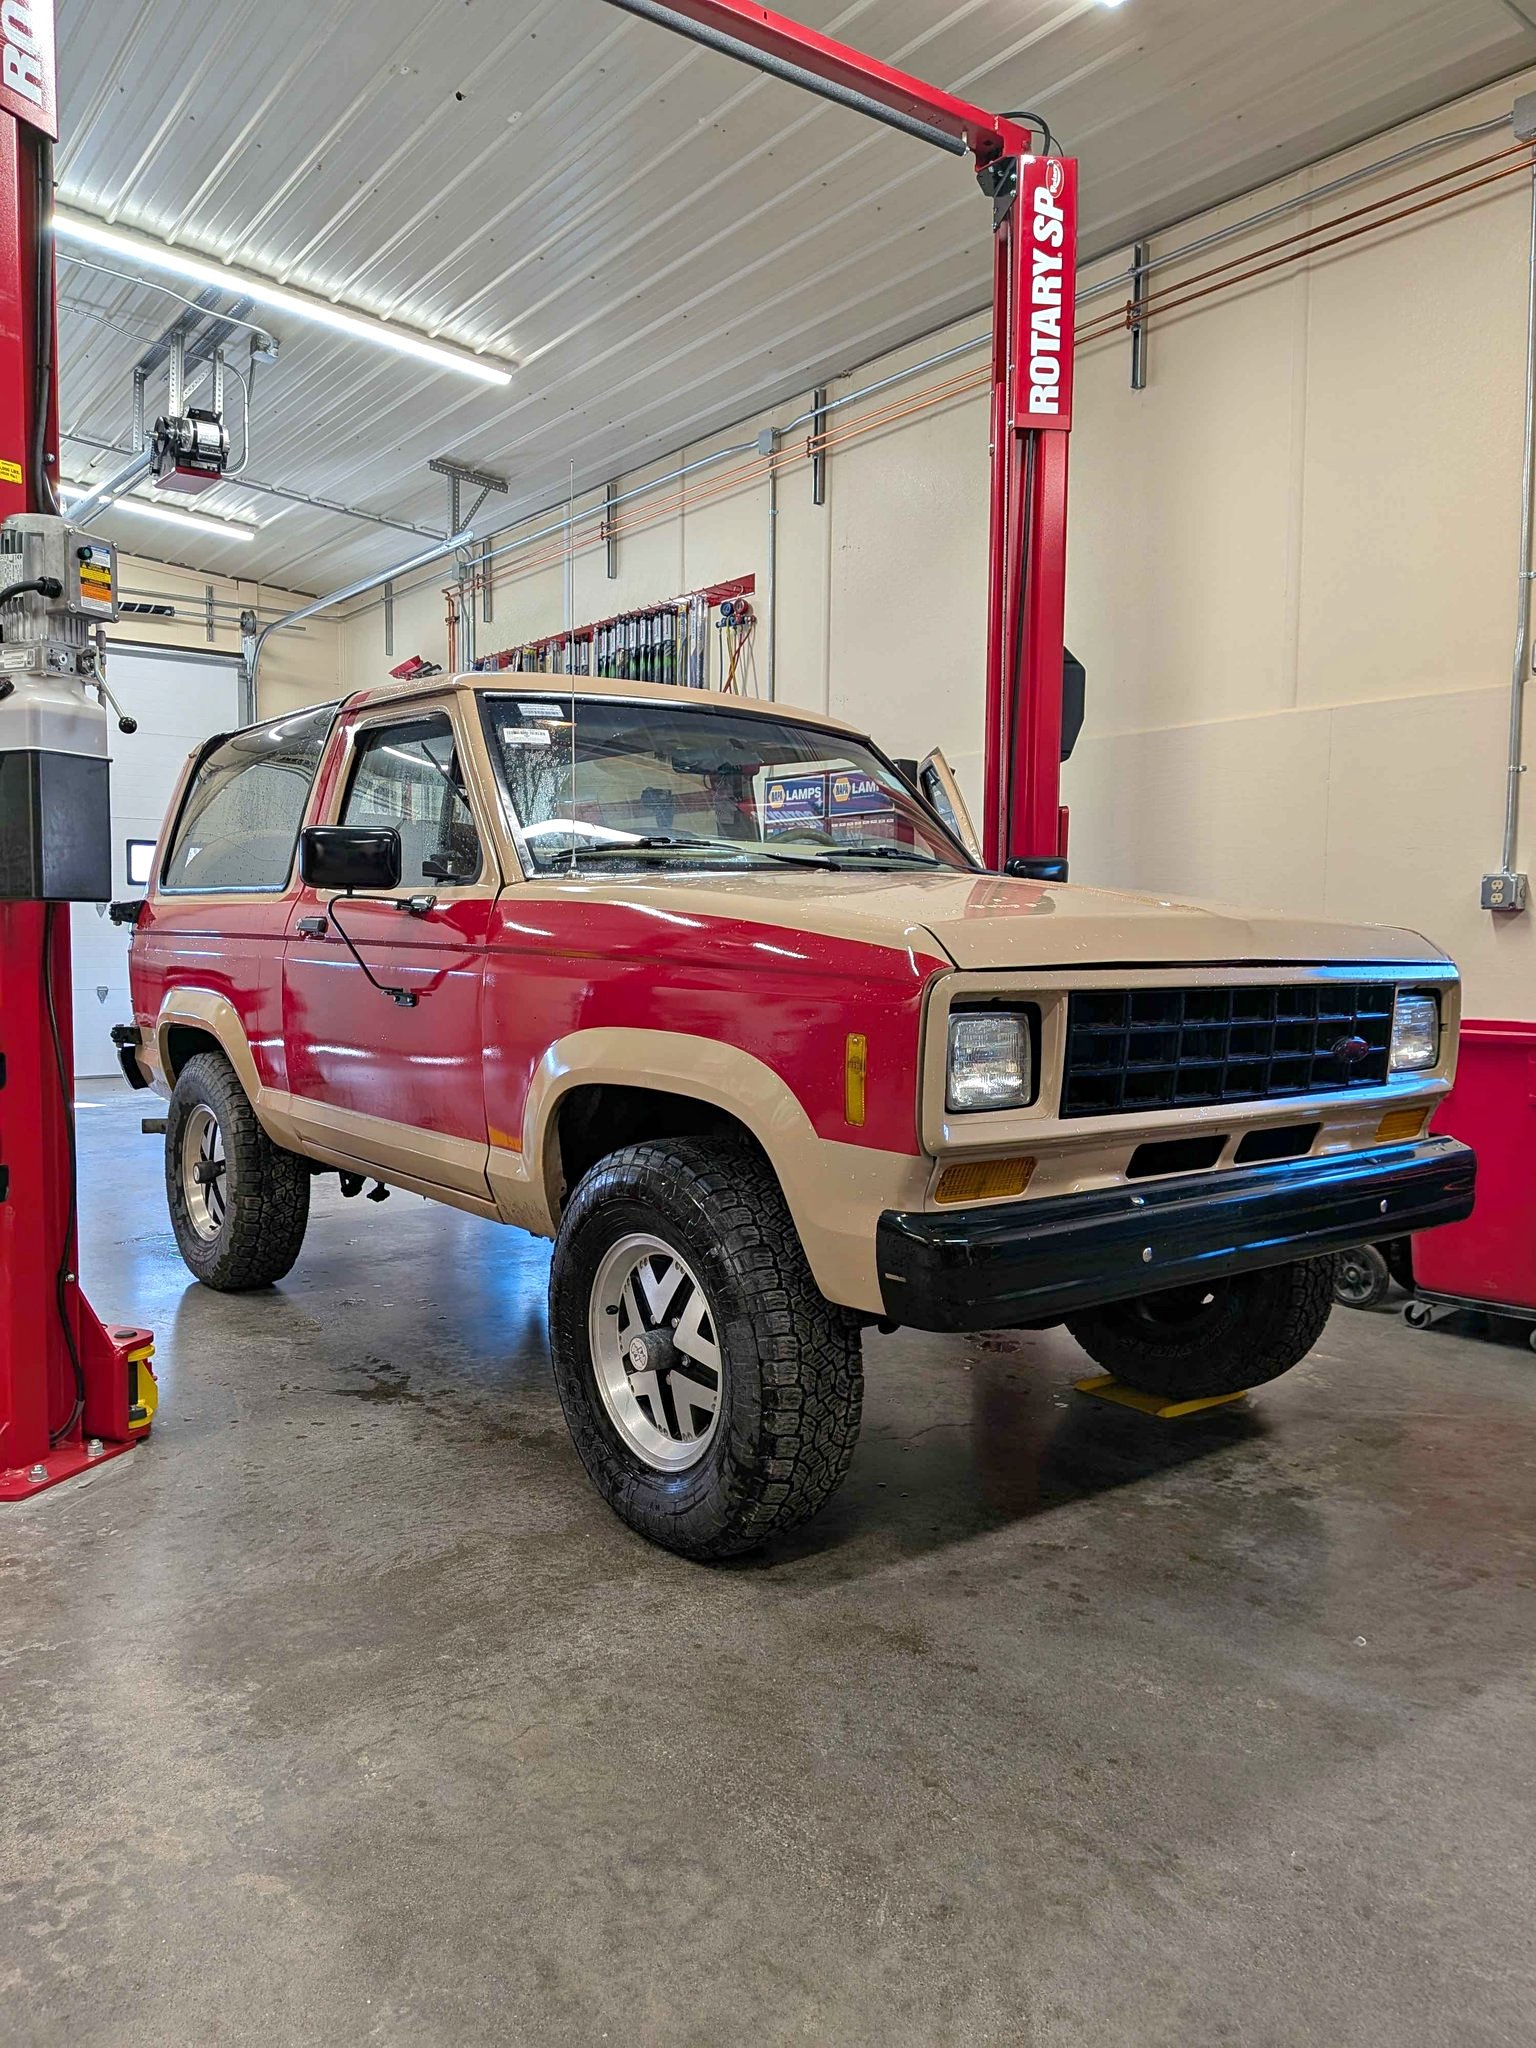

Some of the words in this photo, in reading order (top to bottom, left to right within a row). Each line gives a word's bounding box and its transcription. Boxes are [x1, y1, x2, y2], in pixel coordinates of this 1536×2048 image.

[1032, 186, 1064, 248] SP
[1029, 248, 1063, 414] ROTARY
[786, 786, 822, 801] LAMPS
